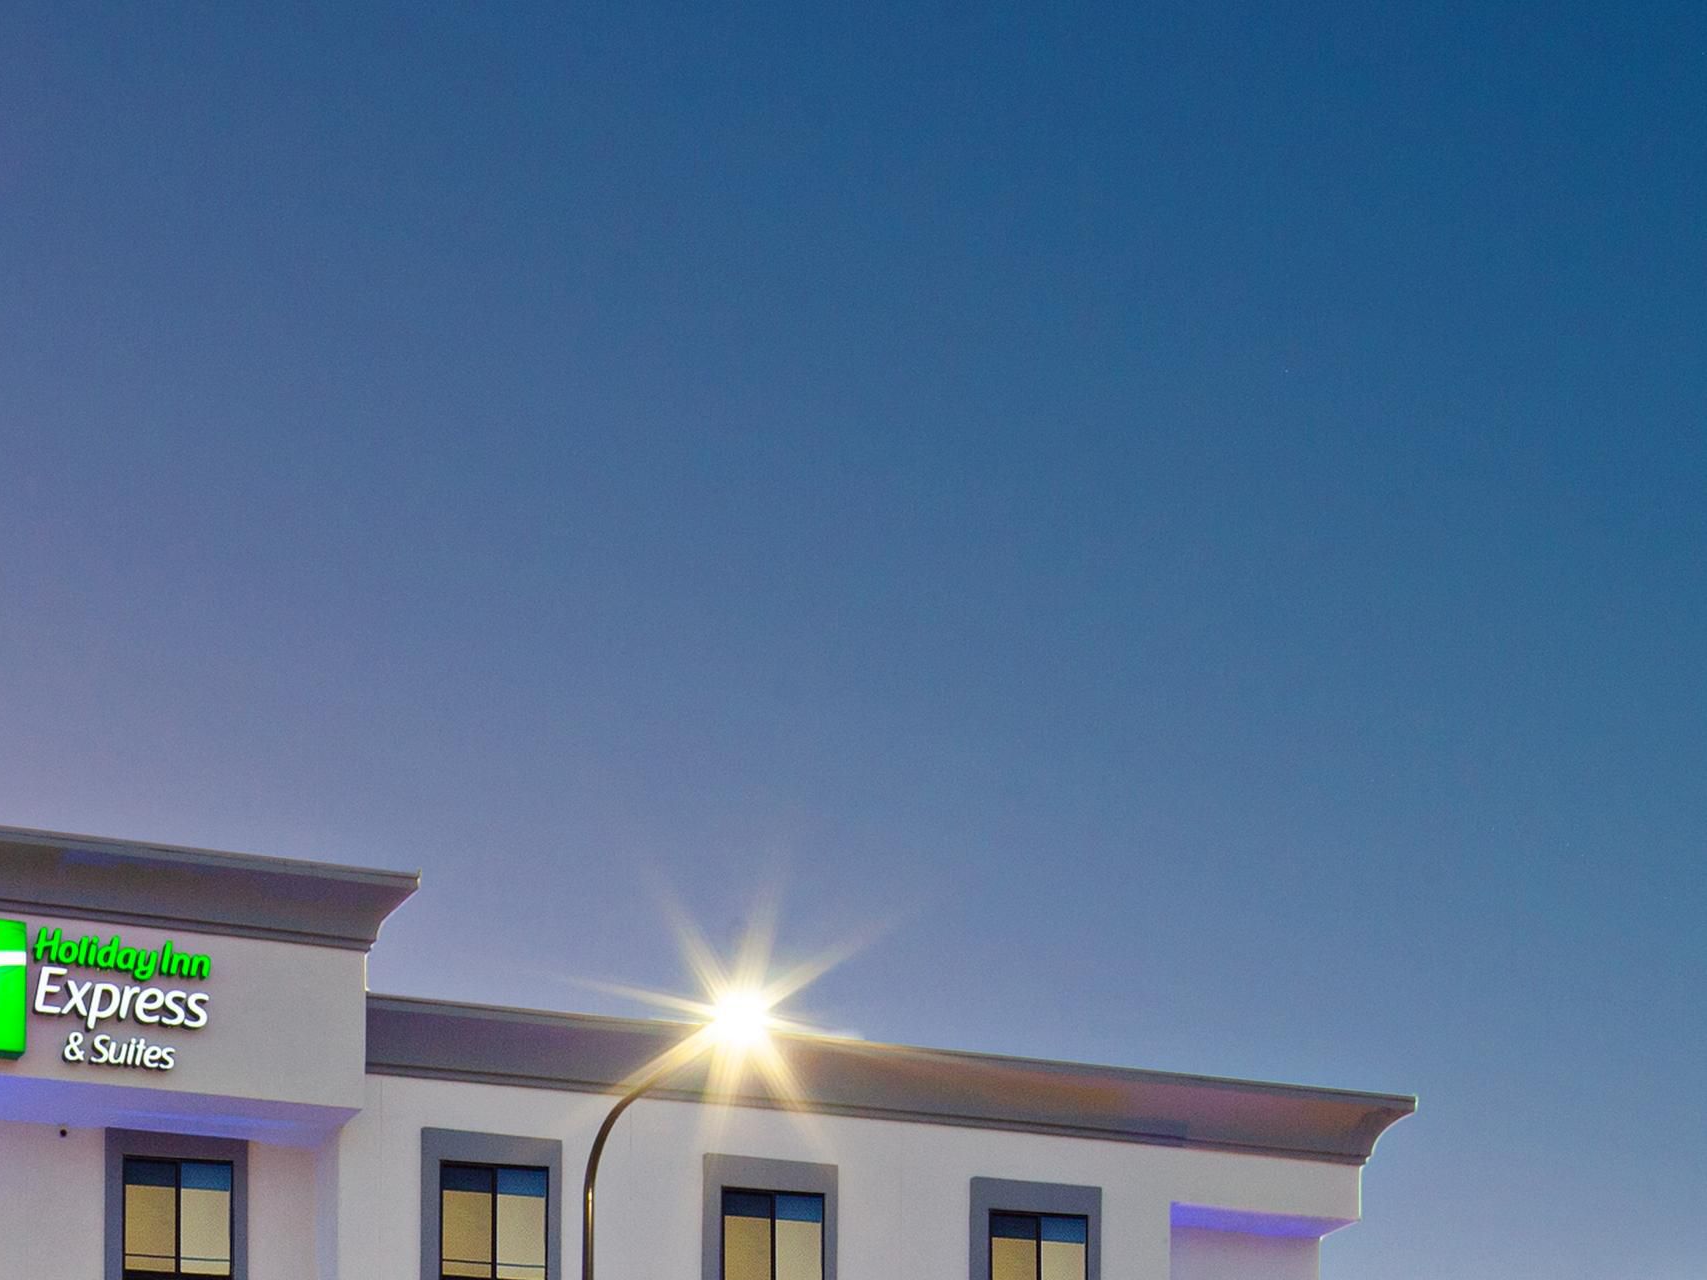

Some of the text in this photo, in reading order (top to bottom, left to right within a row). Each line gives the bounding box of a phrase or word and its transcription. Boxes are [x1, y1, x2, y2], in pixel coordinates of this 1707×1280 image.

[33, 926, 212, 981] Holiday Inn
[33, 965, 211, 1031] Express
[63, 1031, 177, 1071] & Suites
